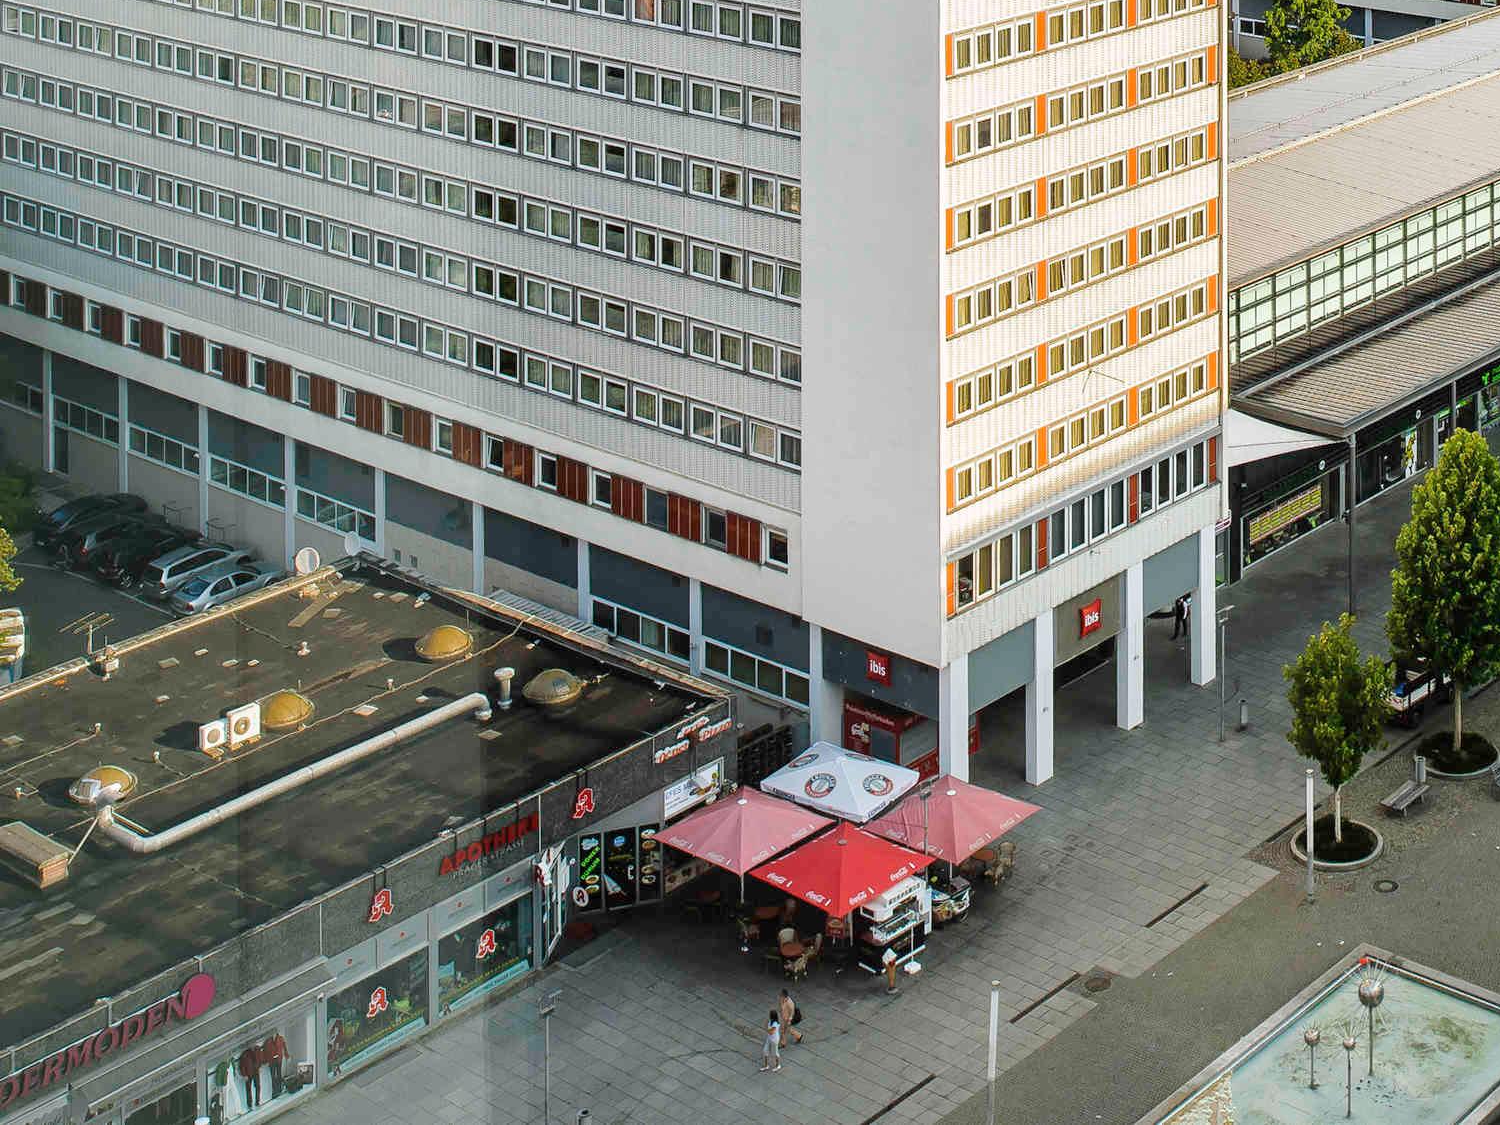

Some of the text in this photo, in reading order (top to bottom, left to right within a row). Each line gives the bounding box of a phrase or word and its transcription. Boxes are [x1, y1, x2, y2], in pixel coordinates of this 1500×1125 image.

[1085, 612, 1099, 627] ibis
[870, 660, 886, 676] ibis
[440, 811, 539, 876] APOTHEKE
